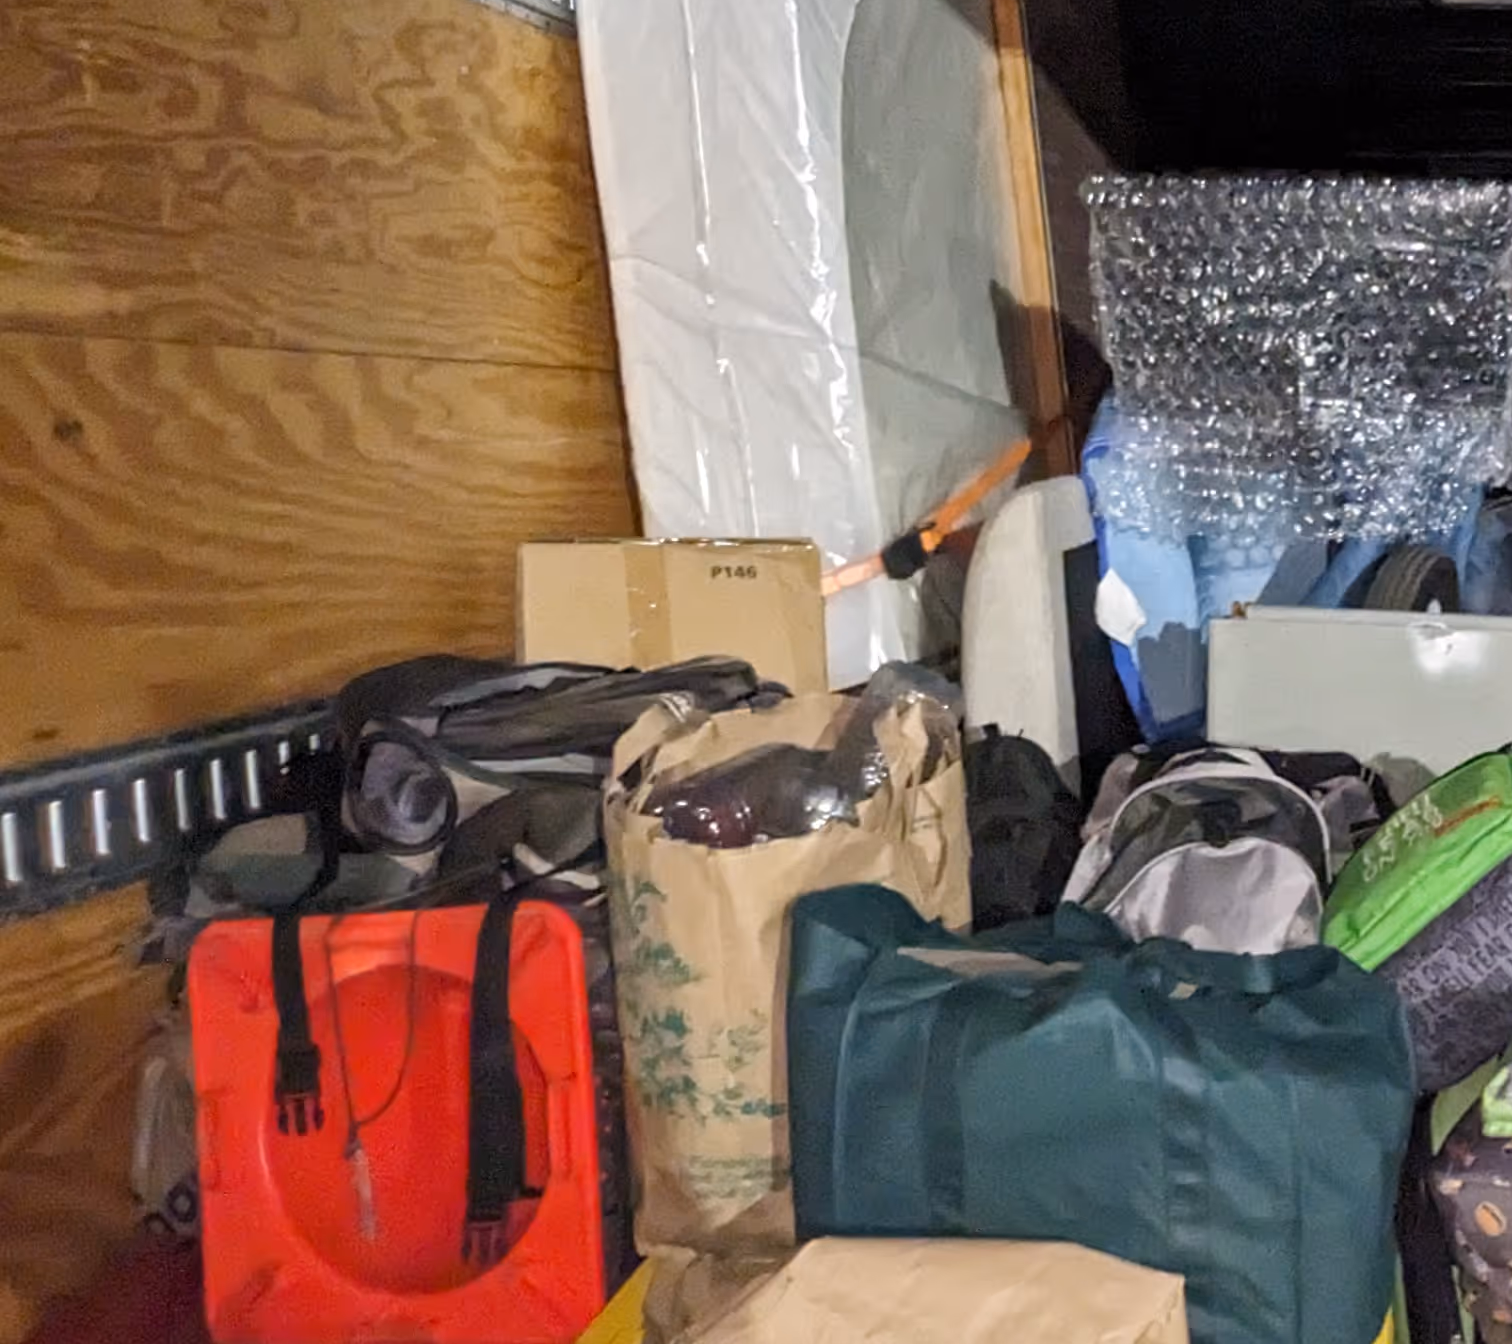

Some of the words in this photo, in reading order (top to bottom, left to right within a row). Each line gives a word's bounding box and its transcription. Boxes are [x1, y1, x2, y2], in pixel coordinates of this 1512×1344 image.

[711, 565, 757, 579] P146
[1419, 953, 1453, 986] ON
[1474, 920, 1490, 938] I
[1465, 934, 1511, 978] FEAR
